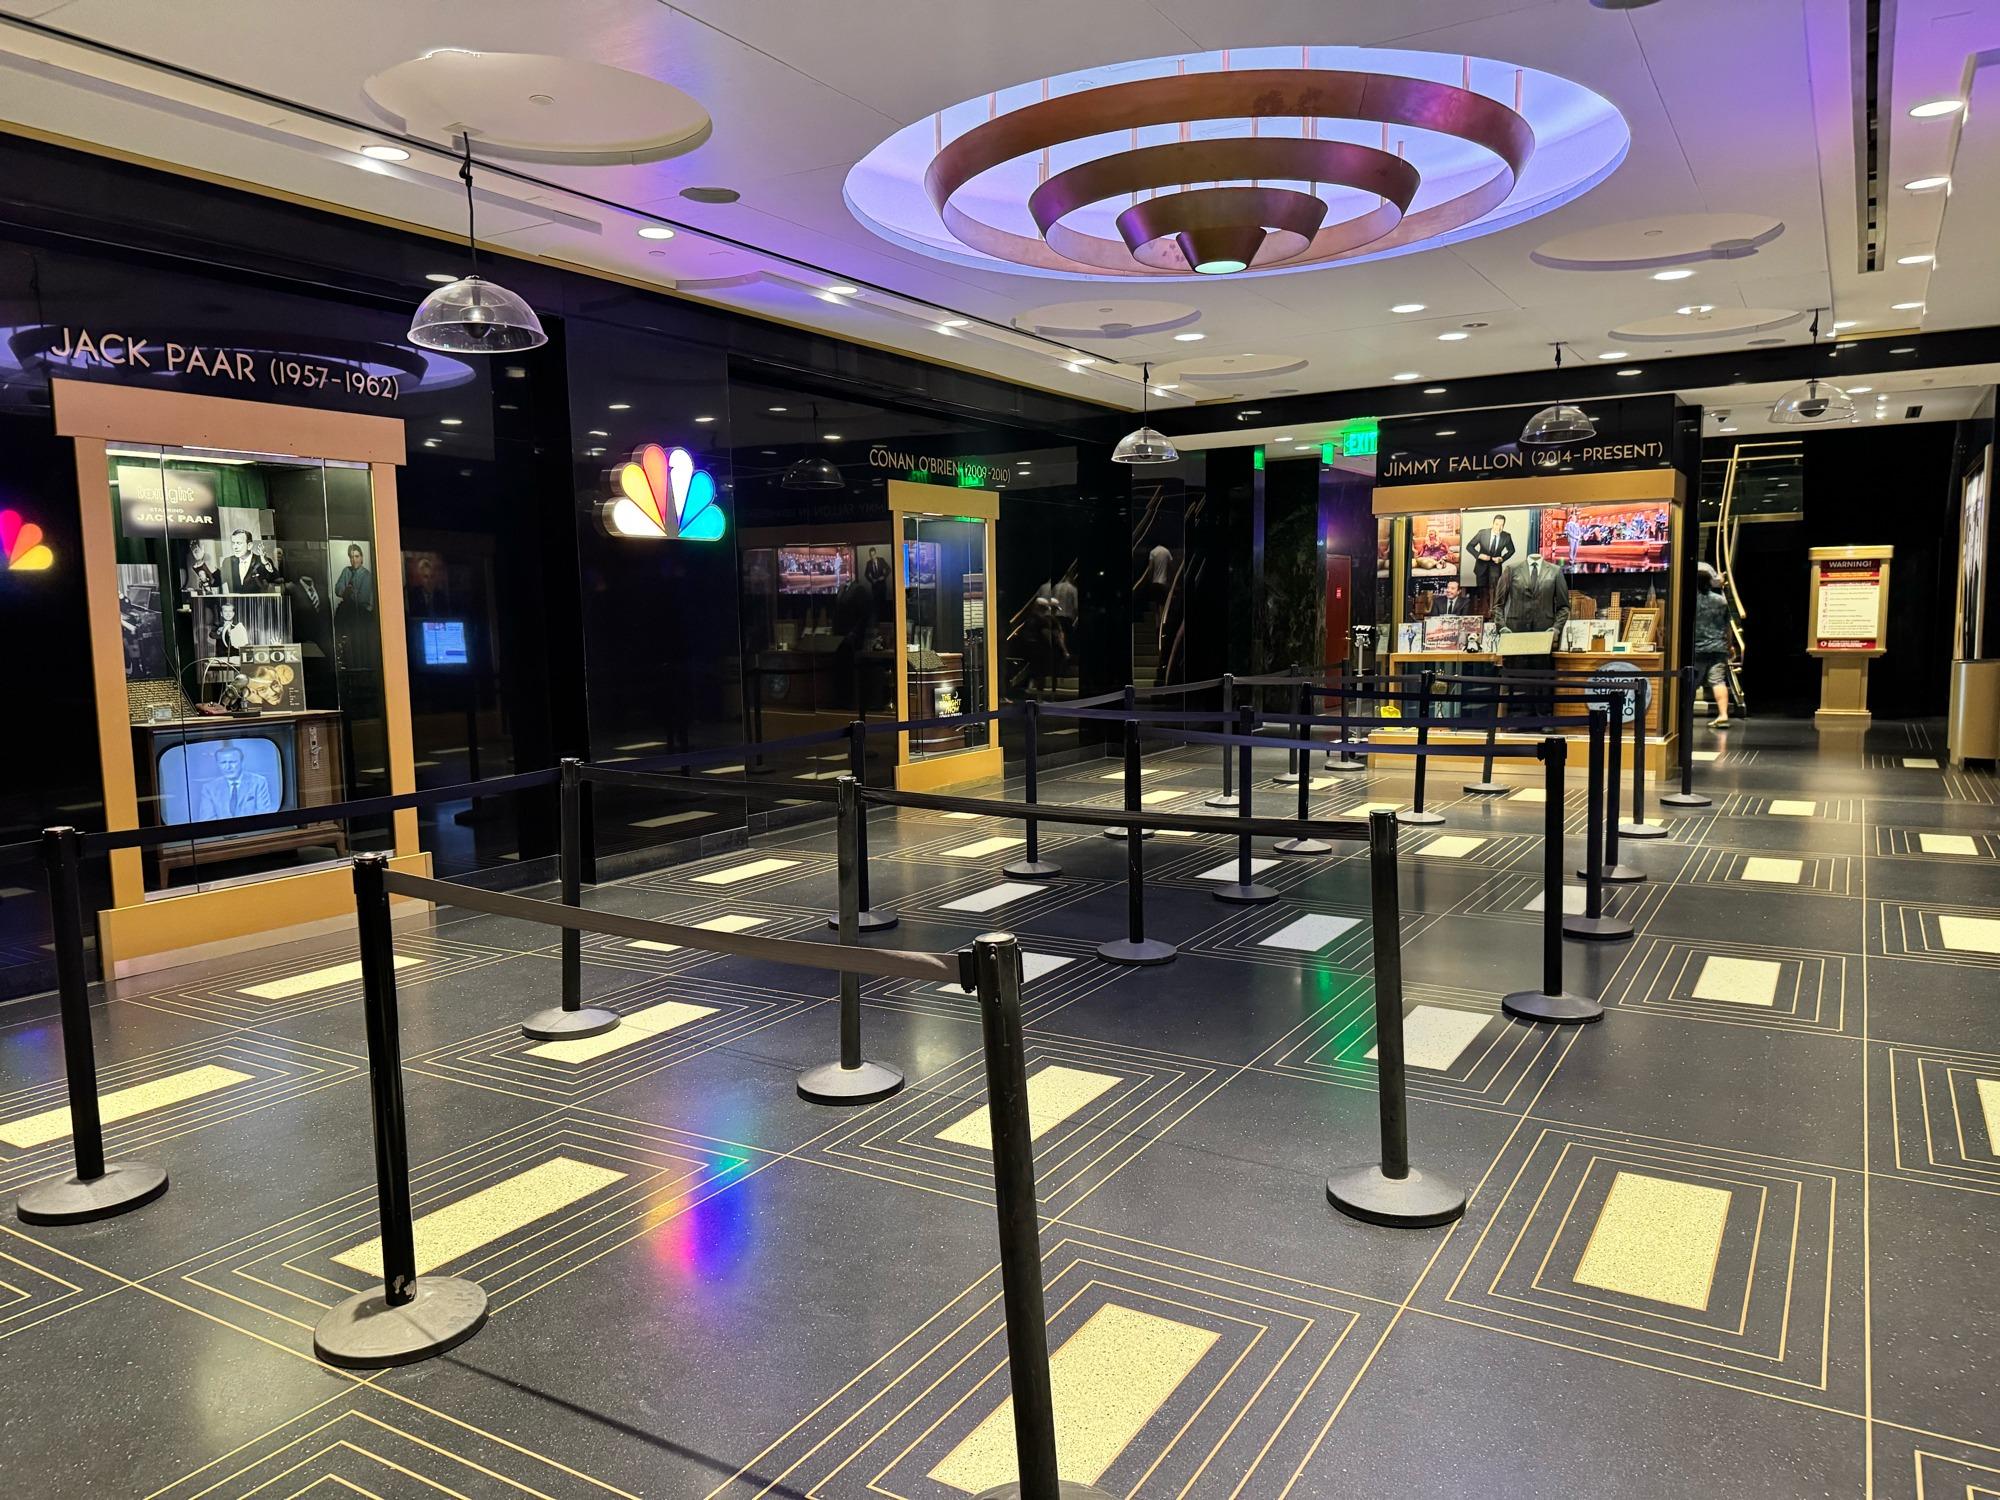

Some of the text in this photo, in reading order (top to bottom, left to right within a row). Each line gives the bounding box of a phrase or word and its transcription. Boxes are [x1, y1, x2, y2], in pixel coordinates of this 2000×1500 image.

[51, 327, 399, 401] JACK PAAR (1957-1962)
[1350, 432, 1377, 453] EXIT
[869, 448, 915, 471] CONAN
[918, 455, 960, 477] O'BRIEN
[1384, 441, 1663, 478] JIMMY FALLON (2014-PRESENT)
[137, 486, 194, 504] tonght
[137, 513, 213, 524] JACK PAAR
[1829, 560, 1872, 568] WARNING!
[242, 651, 300, 663] LOOK
